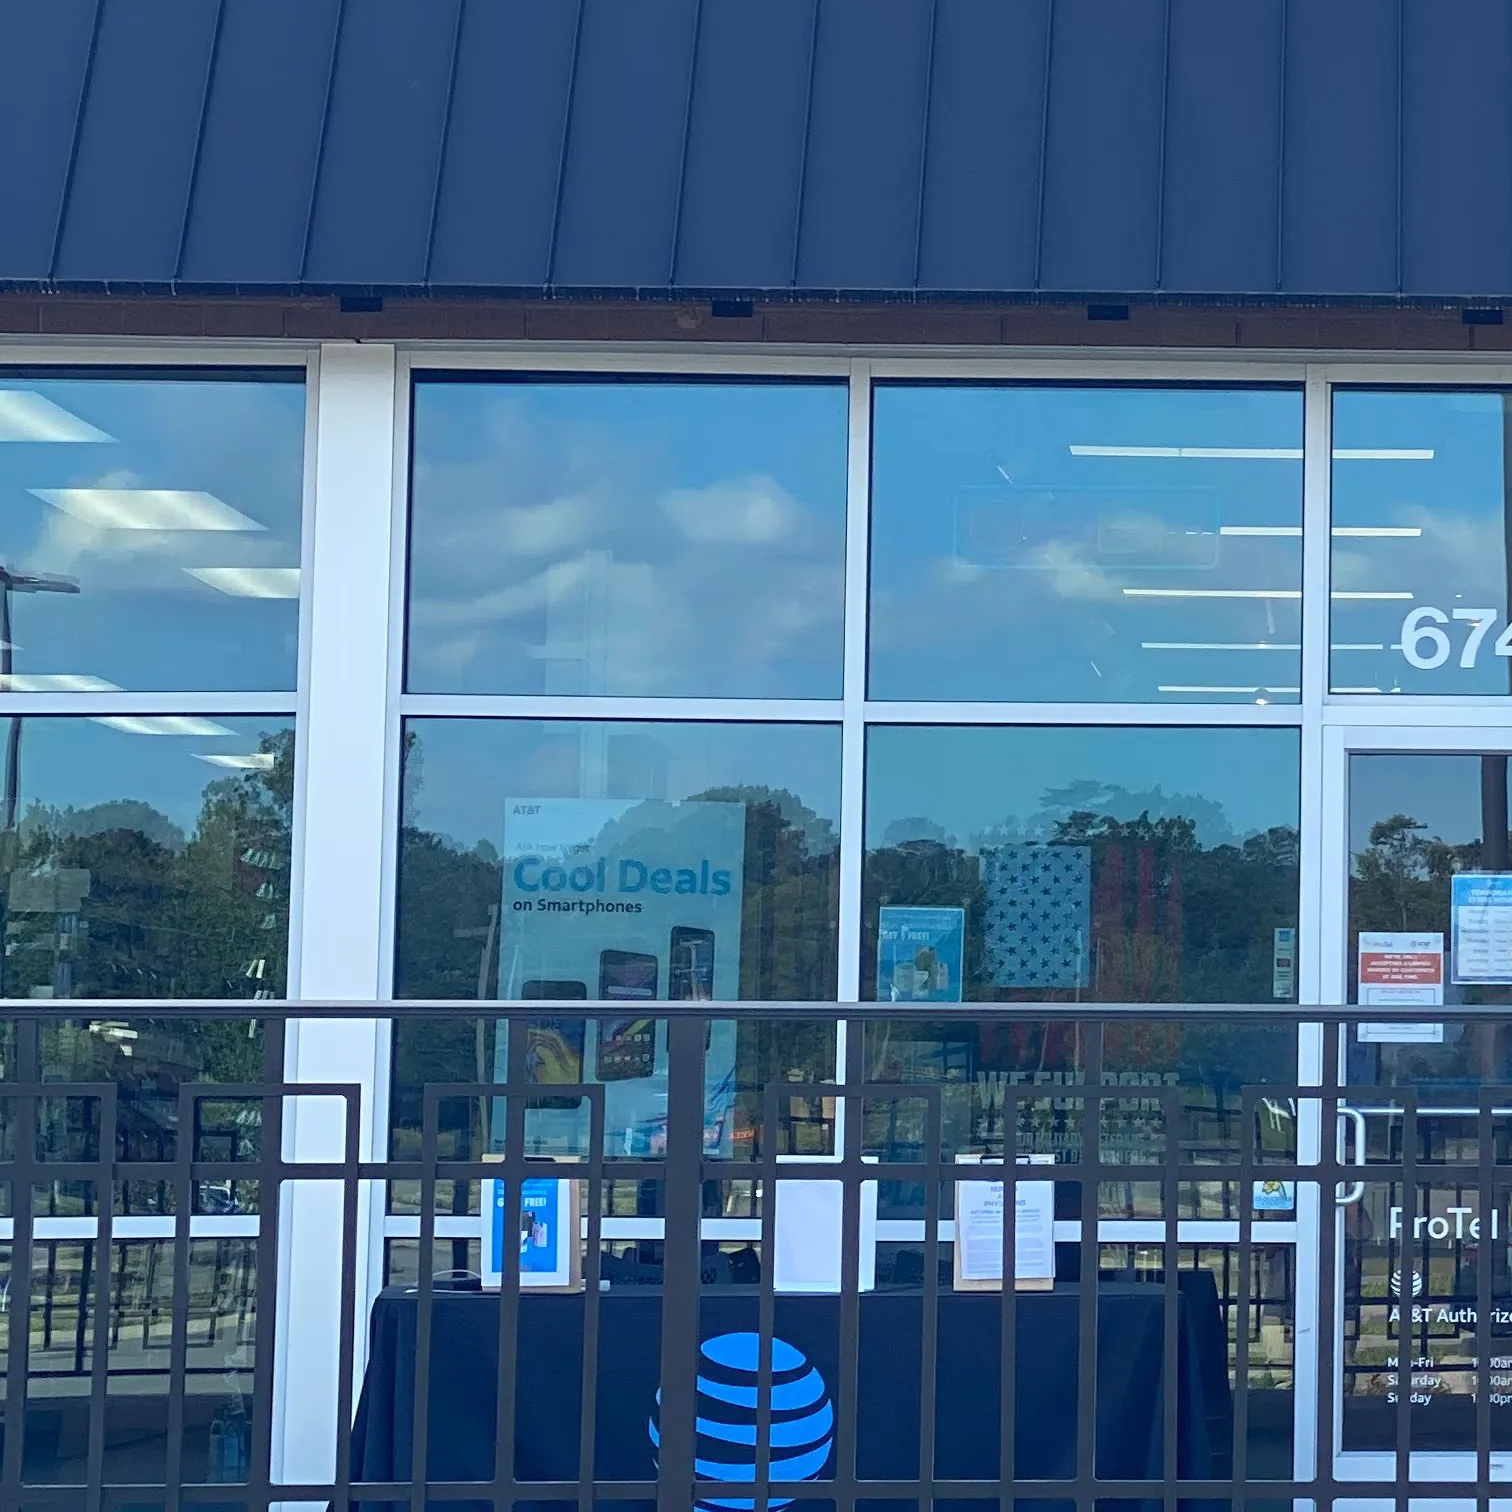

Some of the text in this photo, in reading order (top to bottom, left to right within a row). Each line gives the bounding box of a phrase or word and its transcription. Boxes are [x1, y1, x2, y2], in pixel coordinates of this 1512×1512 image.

[512, 805, 541, 816] AT&T
[513, 857, 732, 896] Cool Deals
[512, 898, 643, 915] on Smartphones
[1390, 1207, 1498, 1239] ProTel
[1389, 1307, 1433, 1323] A&T
[1387, 1357, 1434, 1368] M-Fri
[1387, 1374, 1441, 1389] Srday
[1387, 1392, 1432, 1406] Sday
